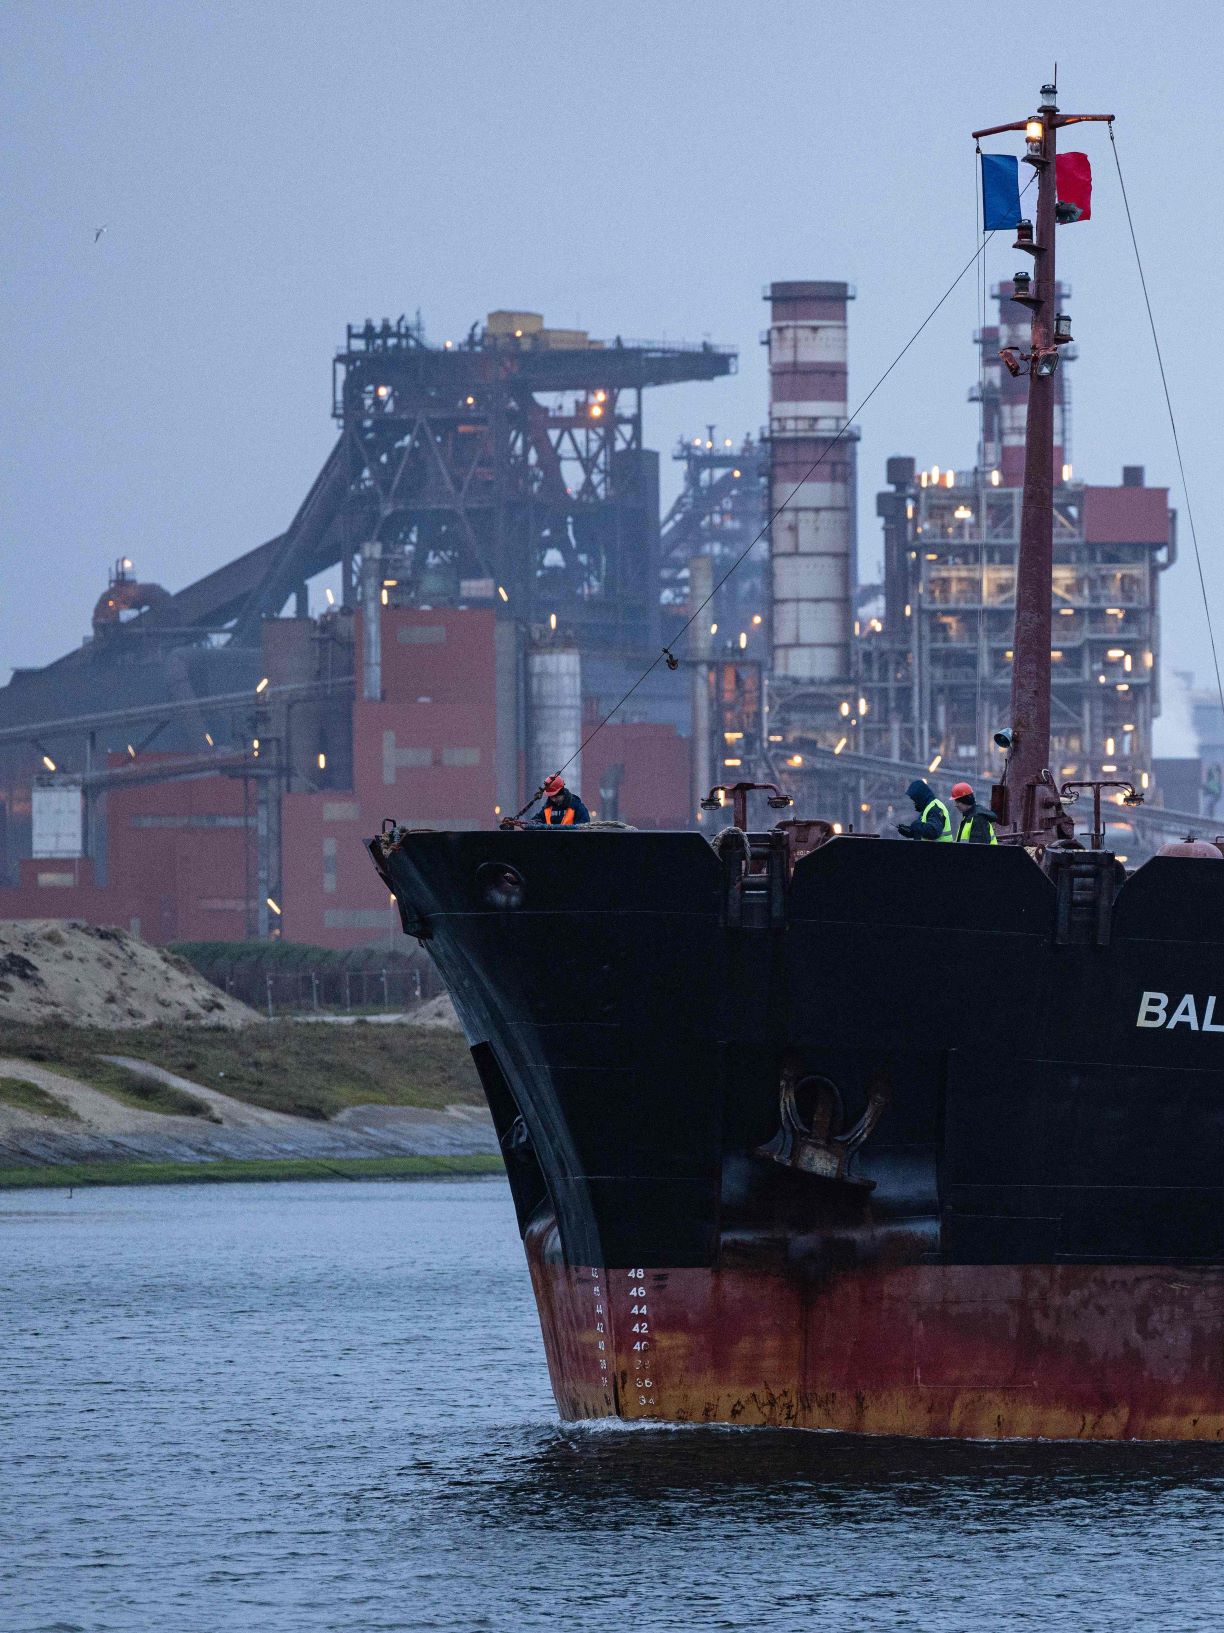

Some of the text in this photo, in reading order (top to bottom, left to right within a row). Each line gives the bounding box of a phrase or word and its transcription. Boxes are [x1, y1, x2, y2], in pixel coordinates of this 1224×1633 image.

[627, 1268, 645, 1279] 48
[629, 1287, 647, 1297] 46
[630, 1305, 647, 1315] 44
[596, 1322, 604, 1333] 42
[632, 1323, 649, 1333] 42
[636, 1378, 653, 1388] 36
